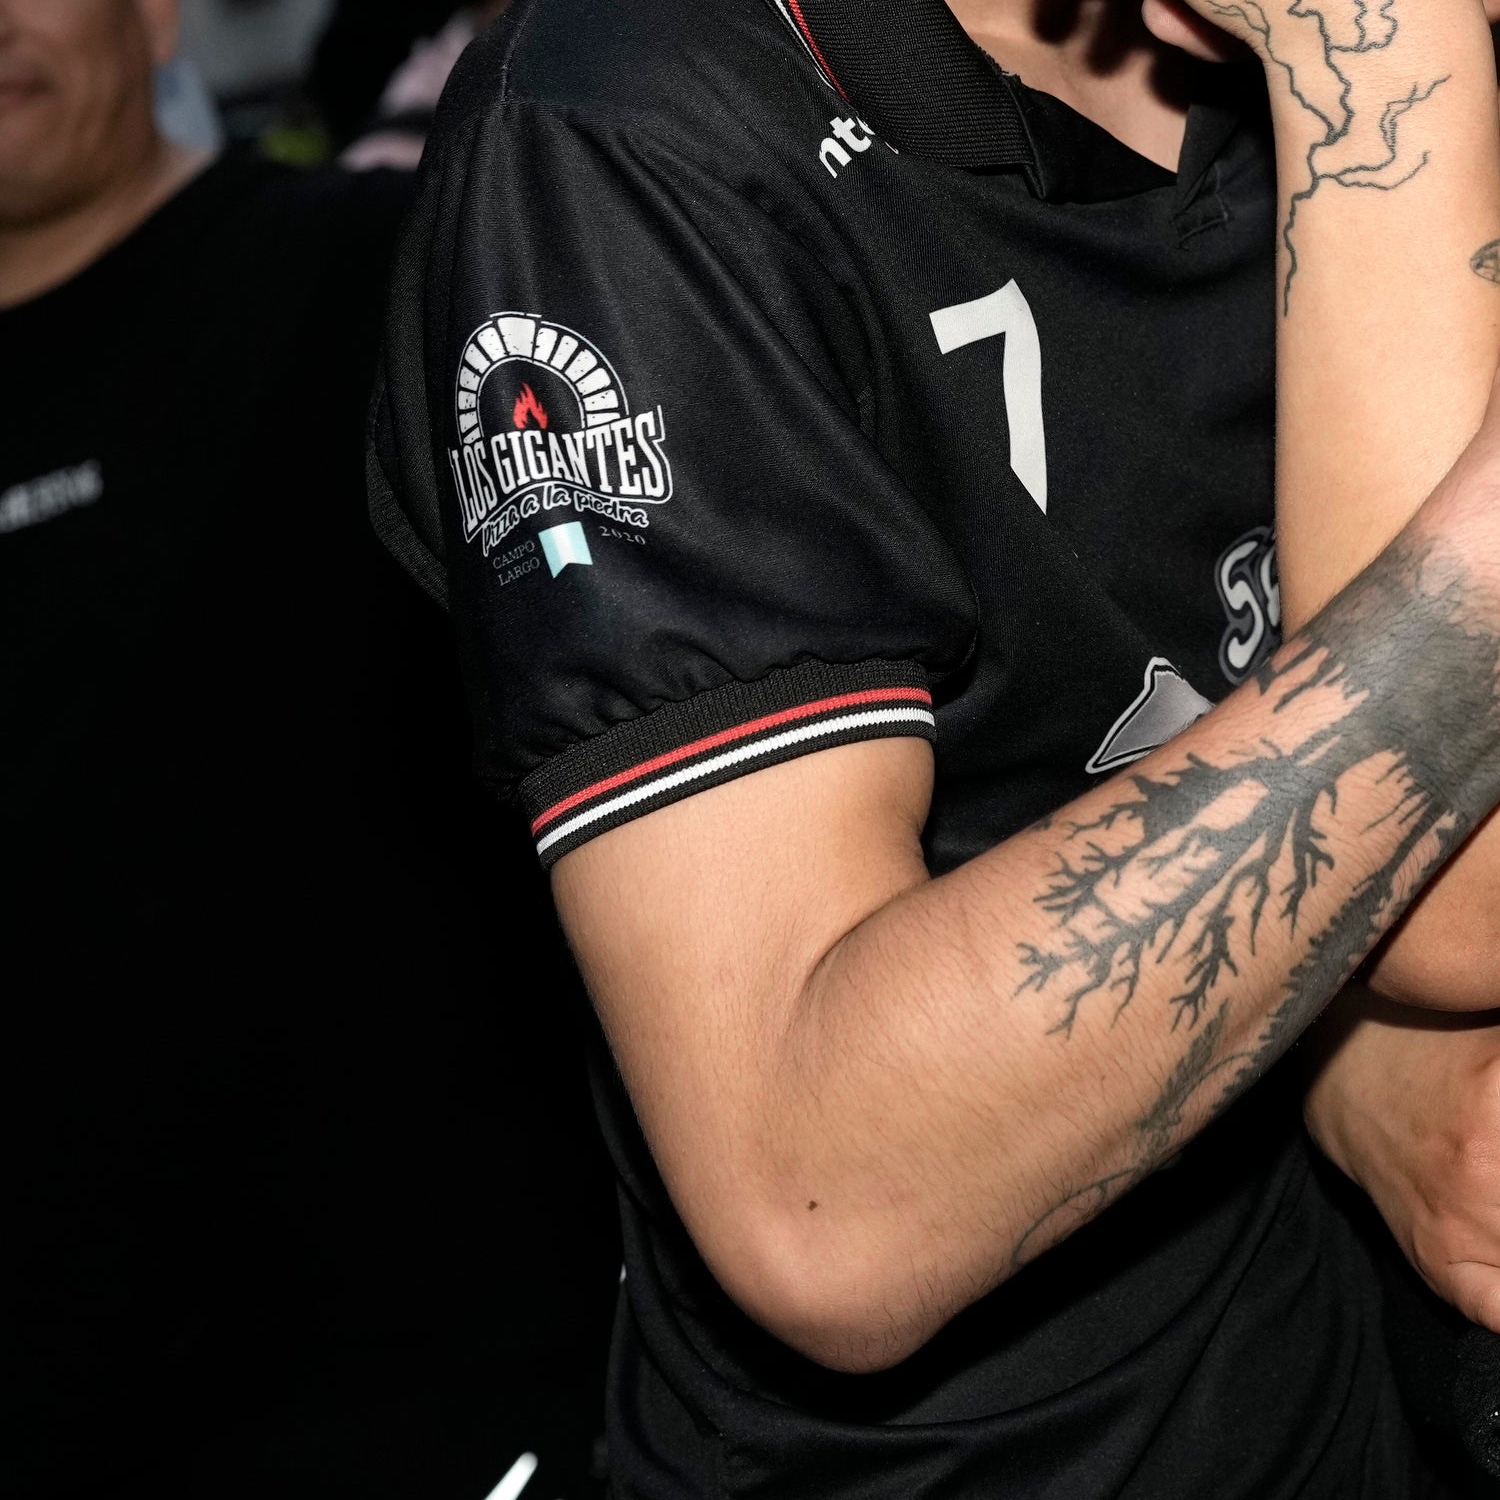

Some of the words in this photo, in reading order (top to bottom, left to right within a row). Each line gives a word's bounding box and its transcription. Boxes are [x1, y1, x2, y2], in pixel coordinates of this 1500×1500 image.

[819, 116, 875, 179] nt
[928, 278, 1048, 516] 7
[451, 442, 498, 534] LOS
[491, 411, 665, 498] GIGANTES
[520, 494, 540, 518] a
[574, 491, 650, 528] piedra
[492, 540, 536, 570] CAMPO
[498, 557, 541, 587] LARGO
